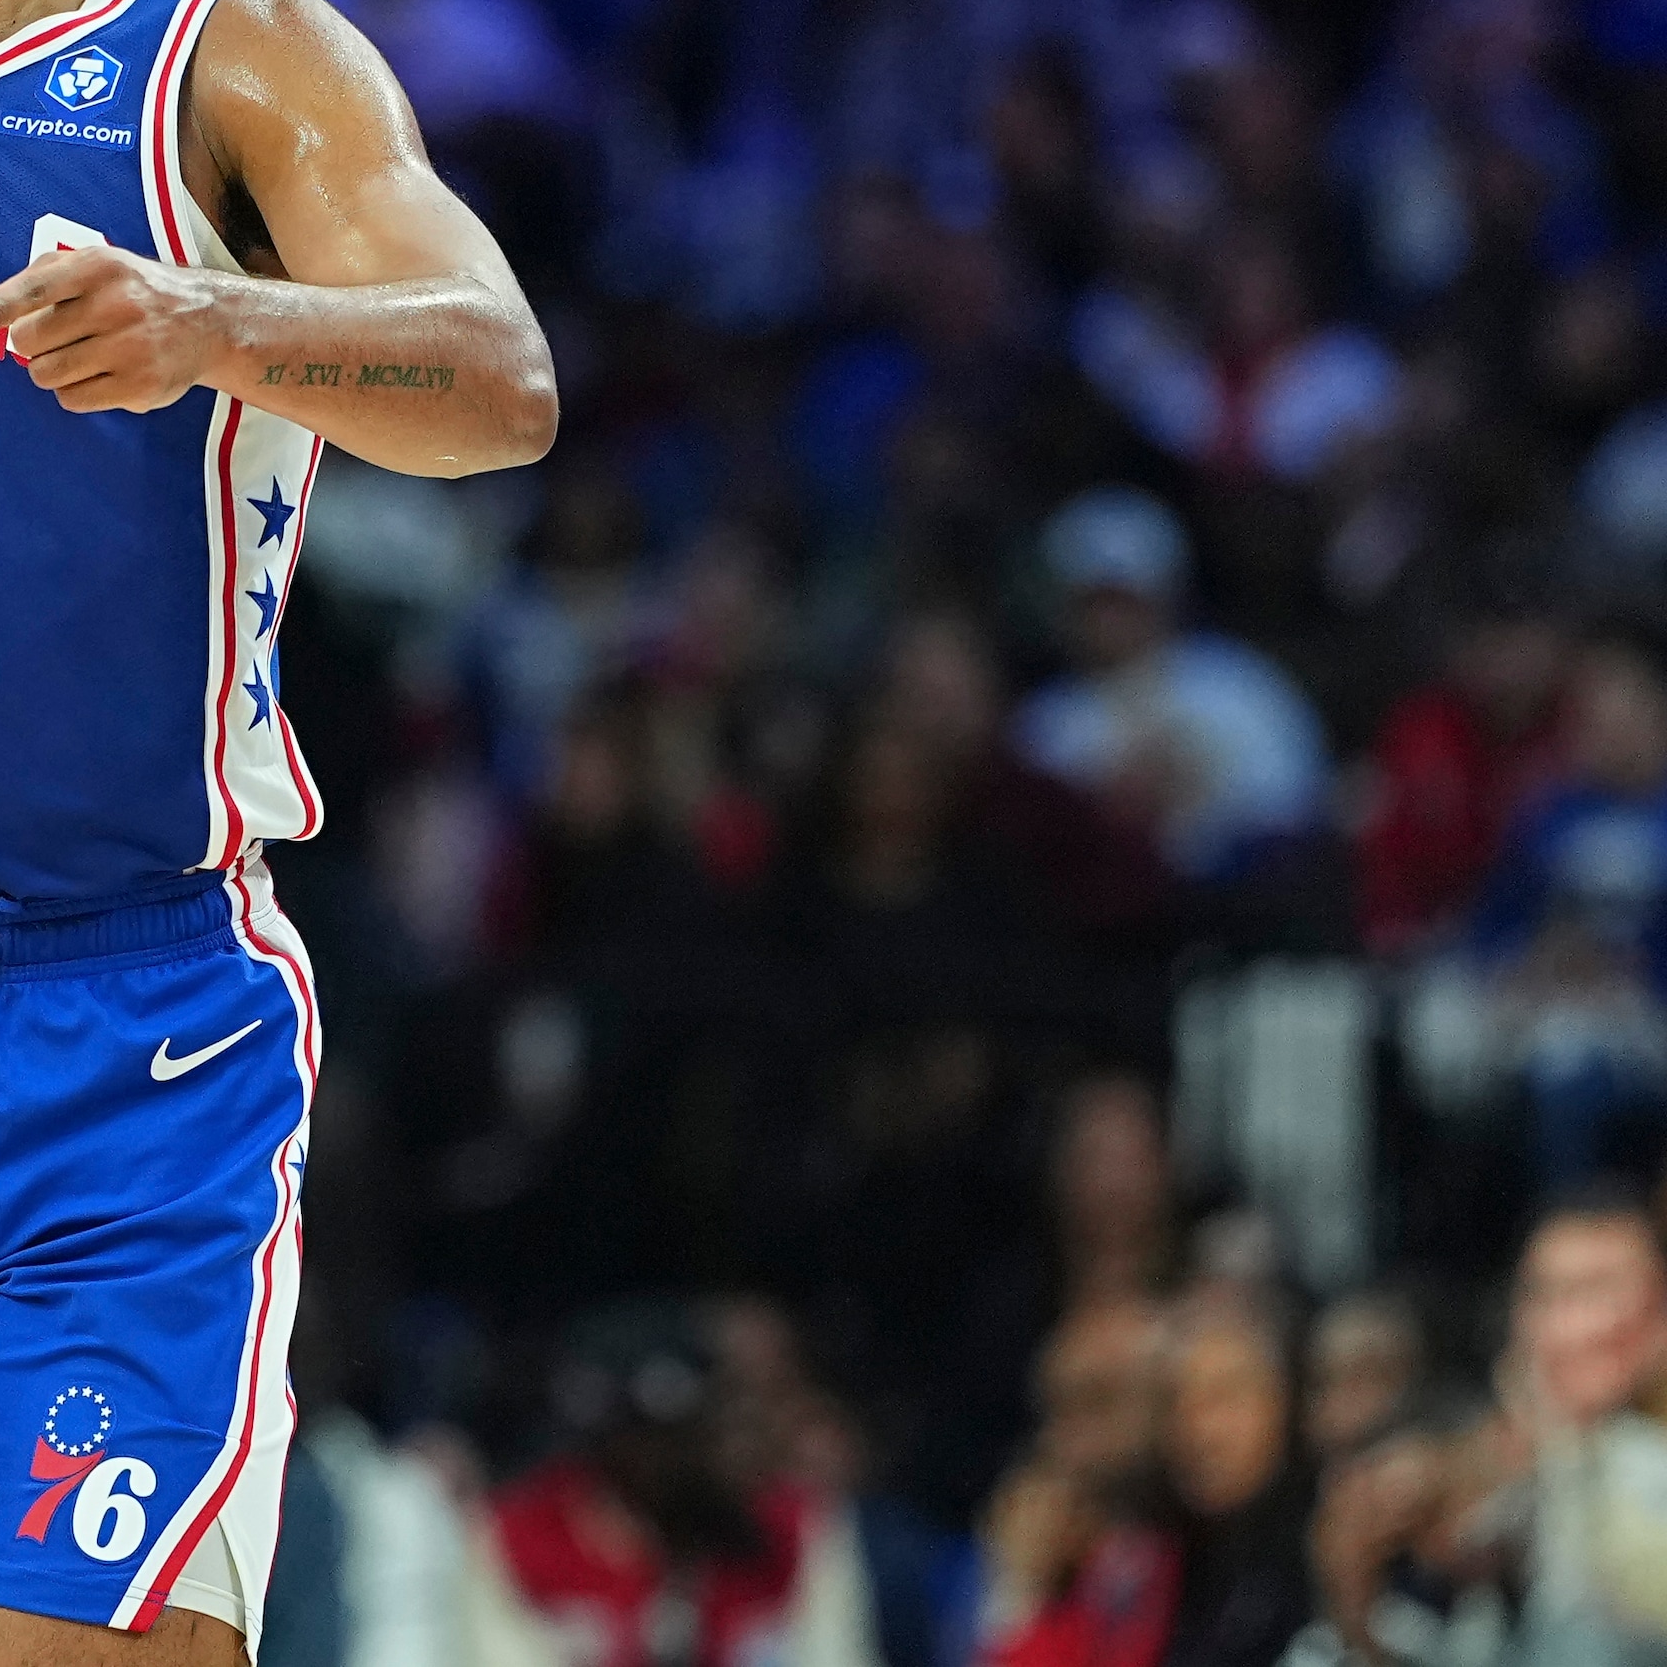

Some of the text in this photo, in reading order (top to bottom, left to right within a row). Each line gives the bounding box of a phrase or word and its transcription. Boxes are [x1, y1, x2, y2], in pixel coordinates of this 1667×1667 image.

[2, 115, 132, 145] crypto.com
[300, 363, 343, 387] XVI
[16, 1434, 157, 1562] 76
